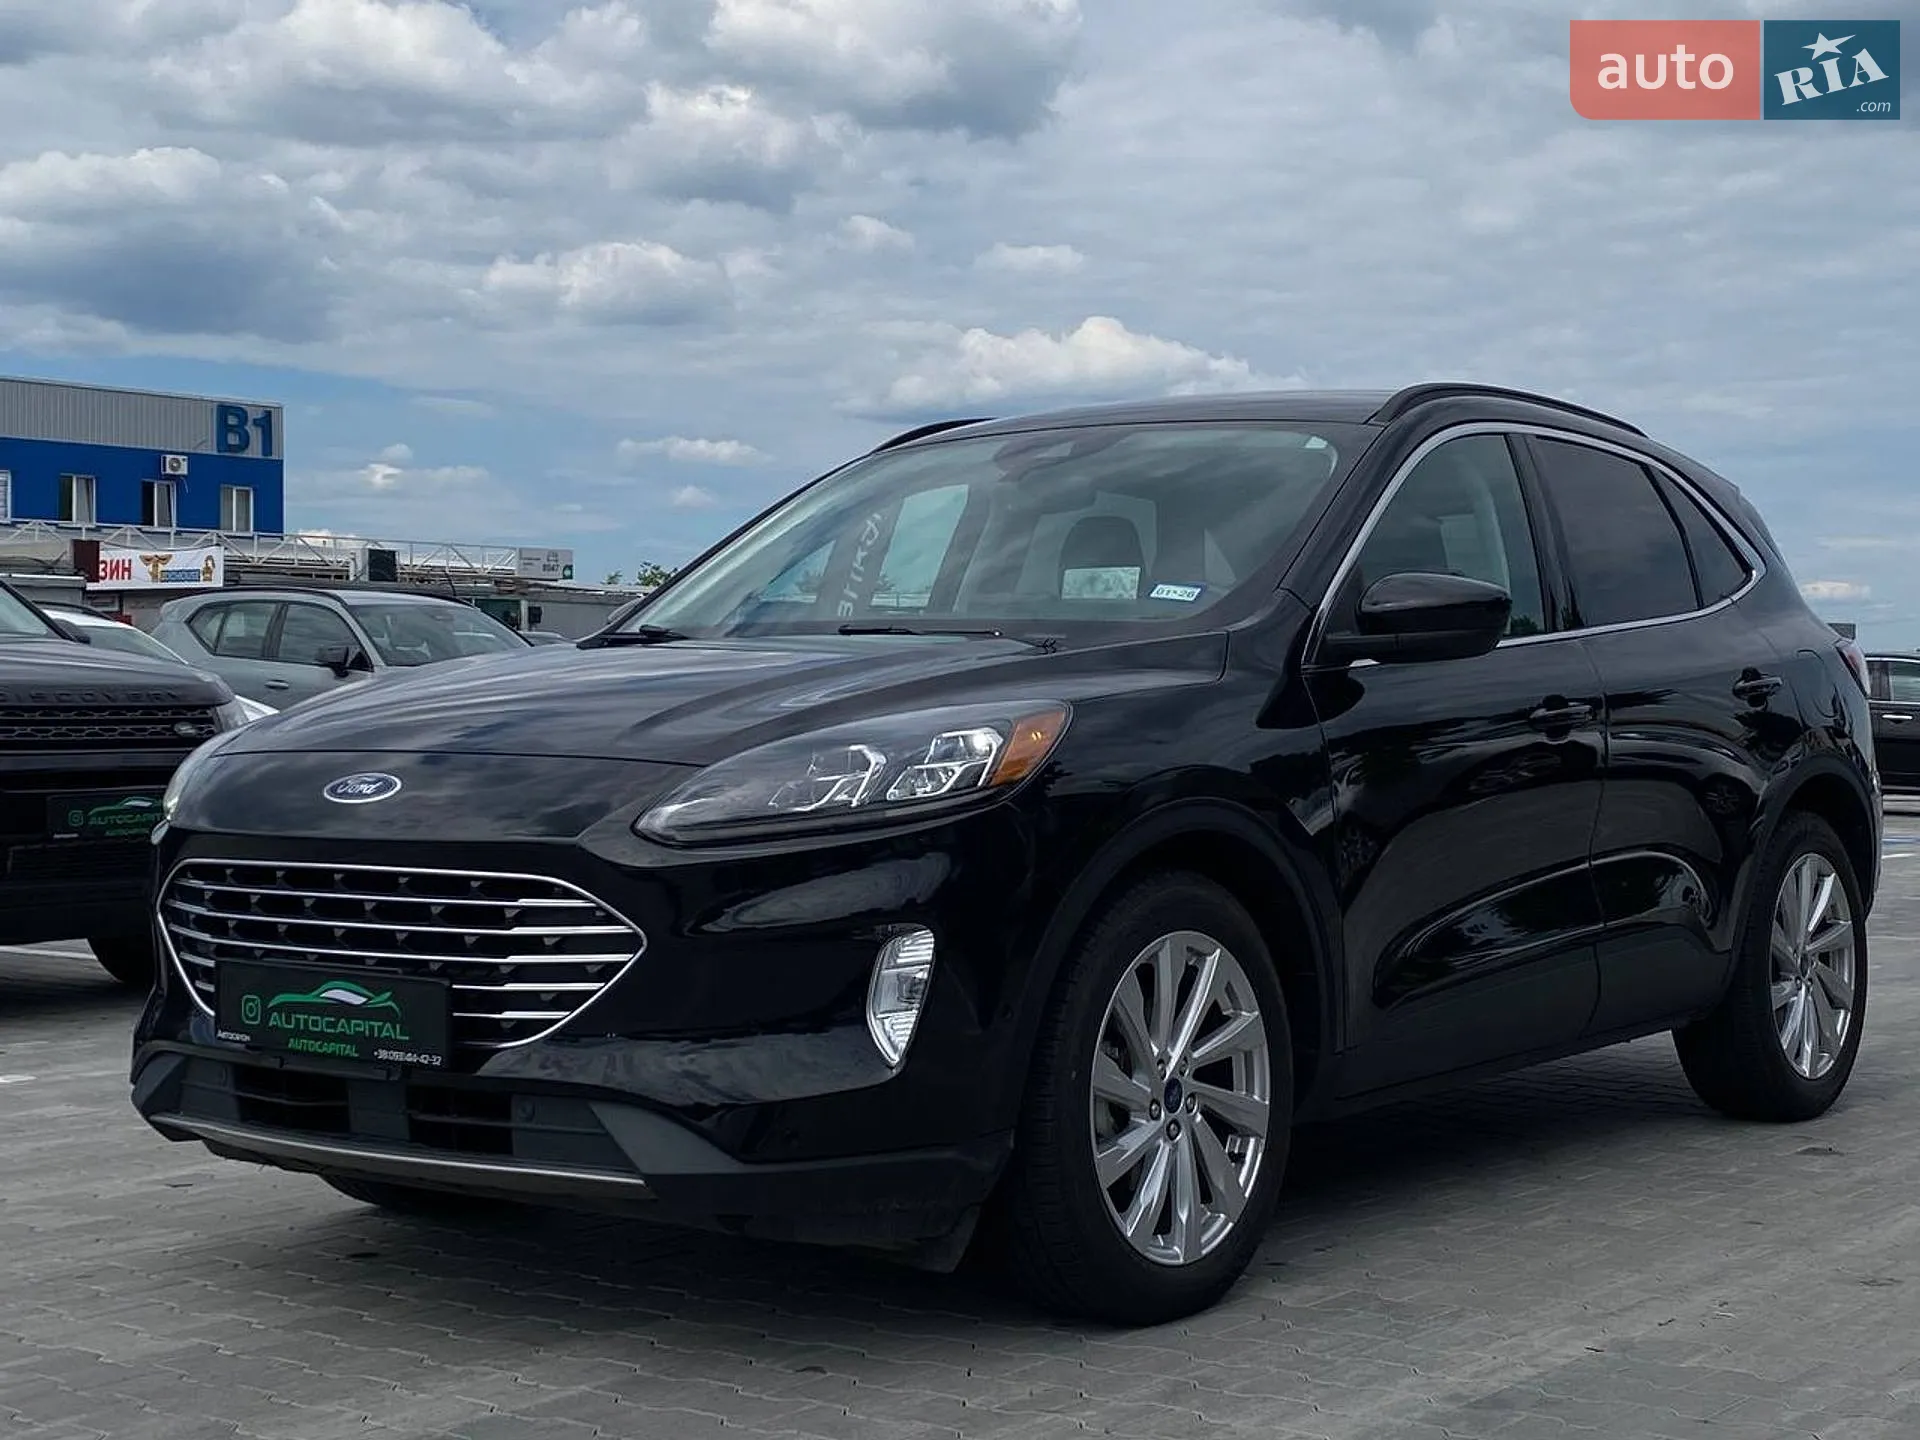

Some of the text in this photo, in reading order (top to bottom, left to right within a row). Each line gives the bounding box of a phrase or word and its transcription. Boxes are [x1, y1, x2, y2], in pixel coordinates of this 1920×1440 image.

[216, 404, 273, 457] B1
[337, 779, 384, 795] Ford
[268, 1011, 410, 1041] AUTOCAPITAL
[287, 1036, 360, 1058] AUTOCAPITAL
